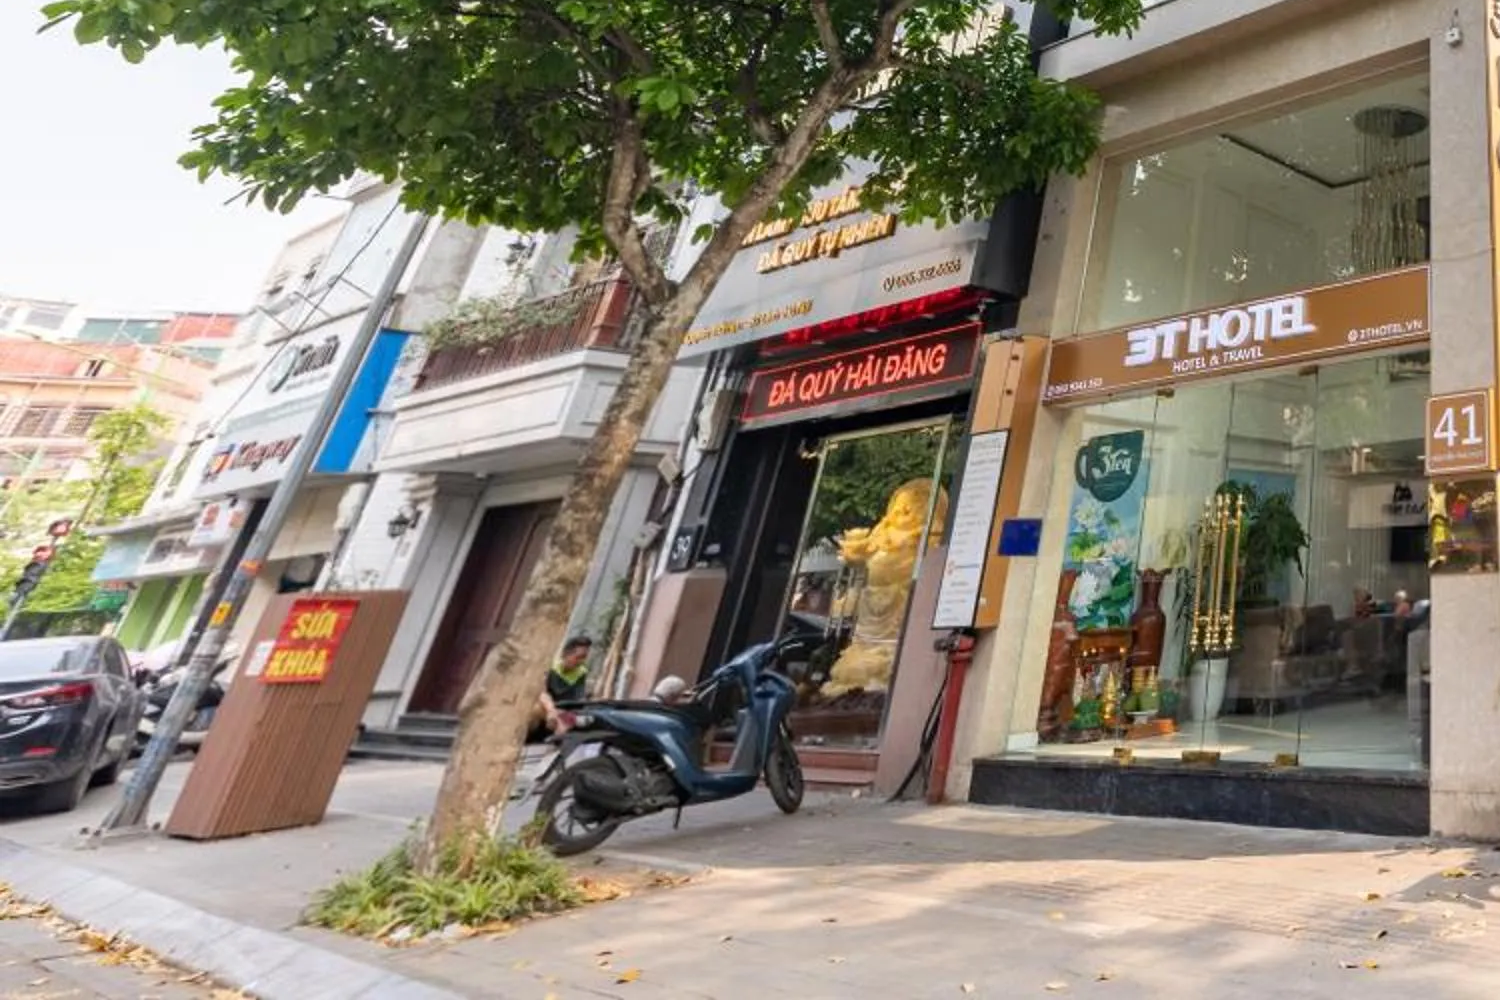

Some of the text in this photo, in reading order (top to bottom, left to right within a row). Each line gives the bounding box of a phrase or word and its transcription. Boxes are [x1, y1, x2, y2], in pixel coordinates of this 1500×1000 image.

[1187, 296, 1317, 353] HOTEL
[767, 343, 948, 408] ĐÁ QUÝ HẢI ĐĂNG
[1172, 356, 1206, 374] HOTEL
[1222, 346, 1264, 364] TRAVEL
[1433, 403, 1483, 448] 41
[264, 642, 328, 679] KHÓA
